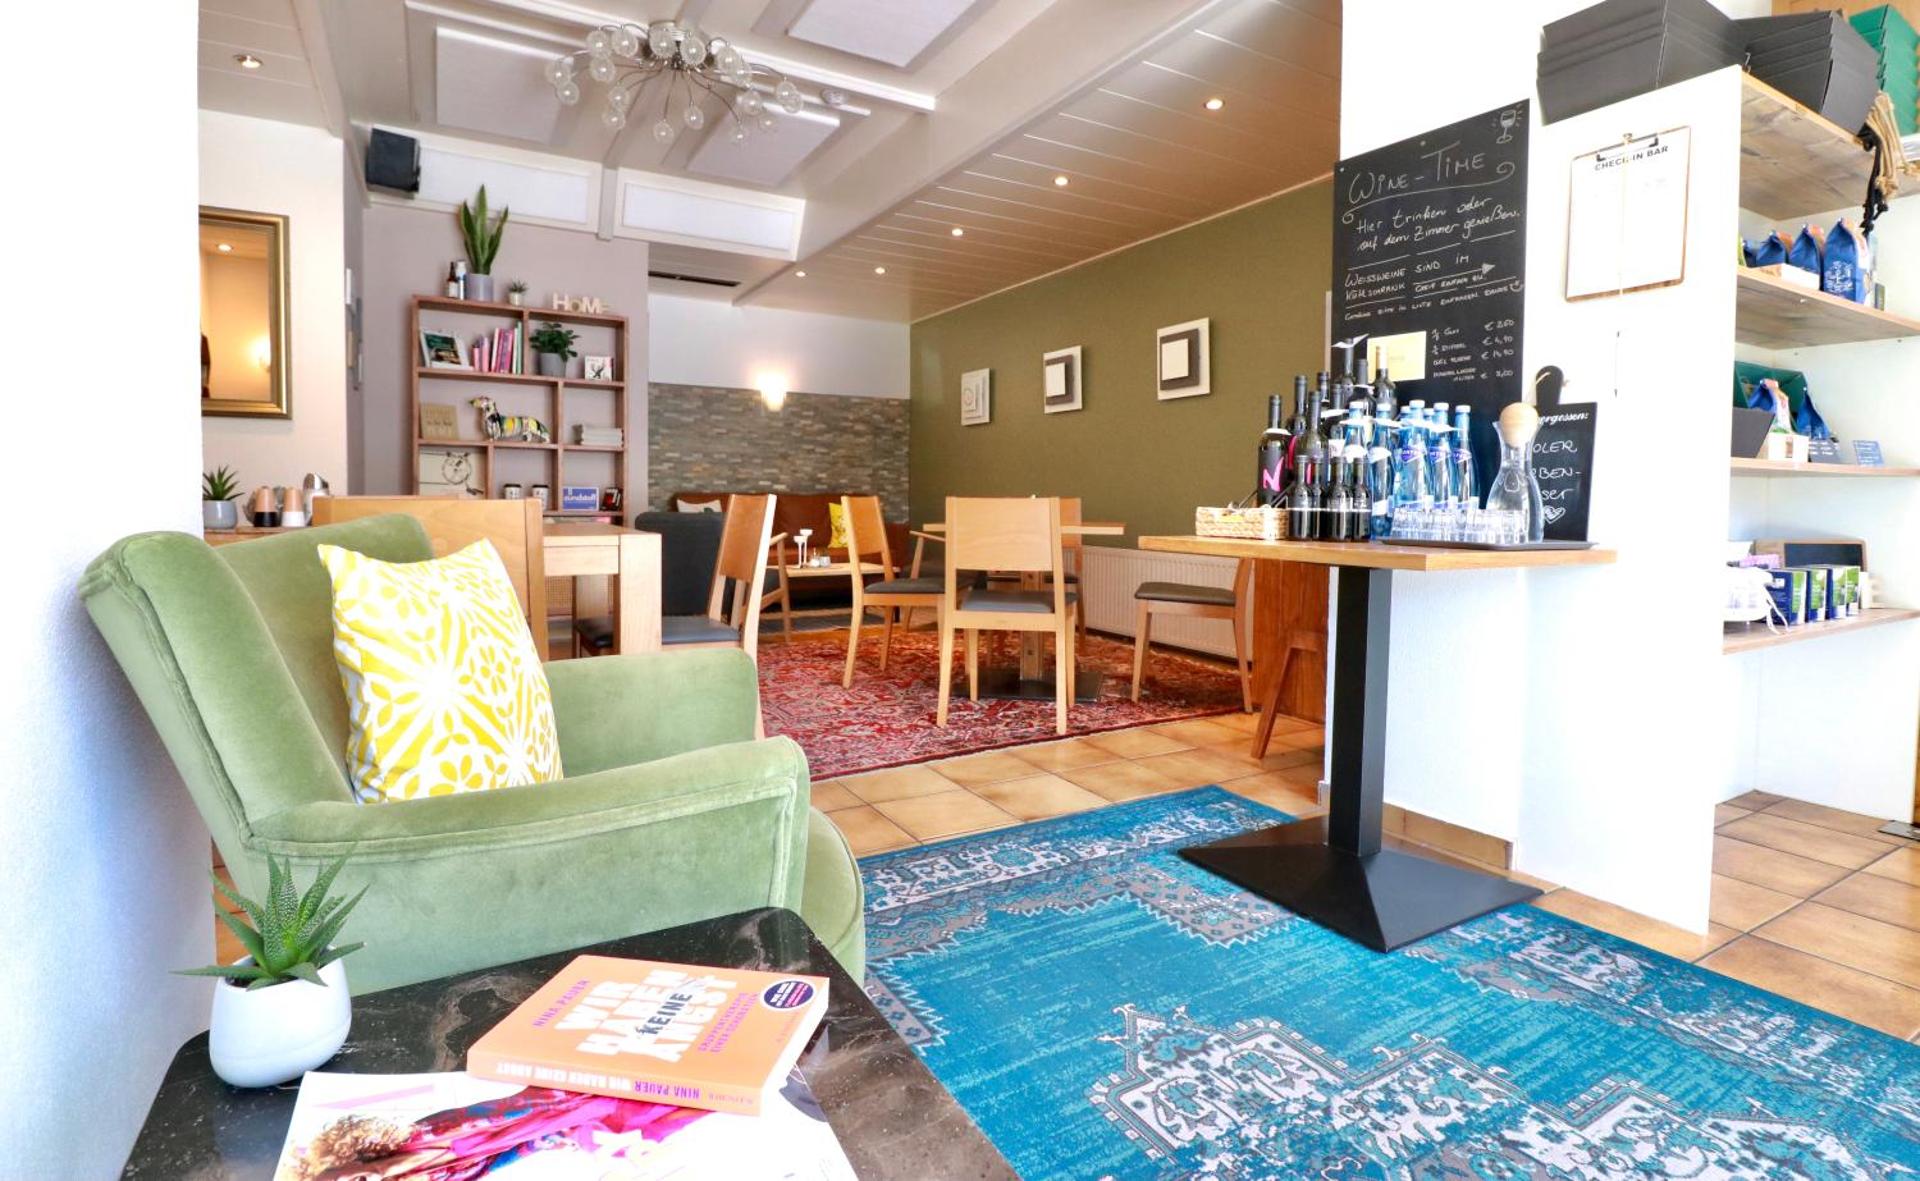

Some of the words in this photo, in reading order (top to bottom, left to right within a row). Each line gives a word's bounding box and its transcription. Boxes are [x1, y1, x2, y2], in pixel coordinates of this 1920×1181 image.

[1646, 145, 1669, 157] BAR
[1356, 219, 1382, 235] Hier
[1392, 208, 1447, 229] trinken
[1457, 196, 1492, 214] oder
[1356, 238, 1377, 253] auf
[1384, 233, 1410, 247] dem
[1414, 223, 1459, 242] Zimmer
[1413, 261, 1441, 273] SIND
[1455, 252, 1469, 264] IM
[1539, 411, 1589, 426] ergessen:
[1532, 440, 1578, 454] OLER
[1542, 488, 1574, 500] ser
[554, 980, 639, 1030] WIR
[575, 969, 690, 1056] HABEN
[639, 992, 693, 1035] KEINE
[622, 974, 737, 1063] ANGST
[634, 1080, 670, 1097] PAUER
[674, 1085, 700, 1100] NINA
